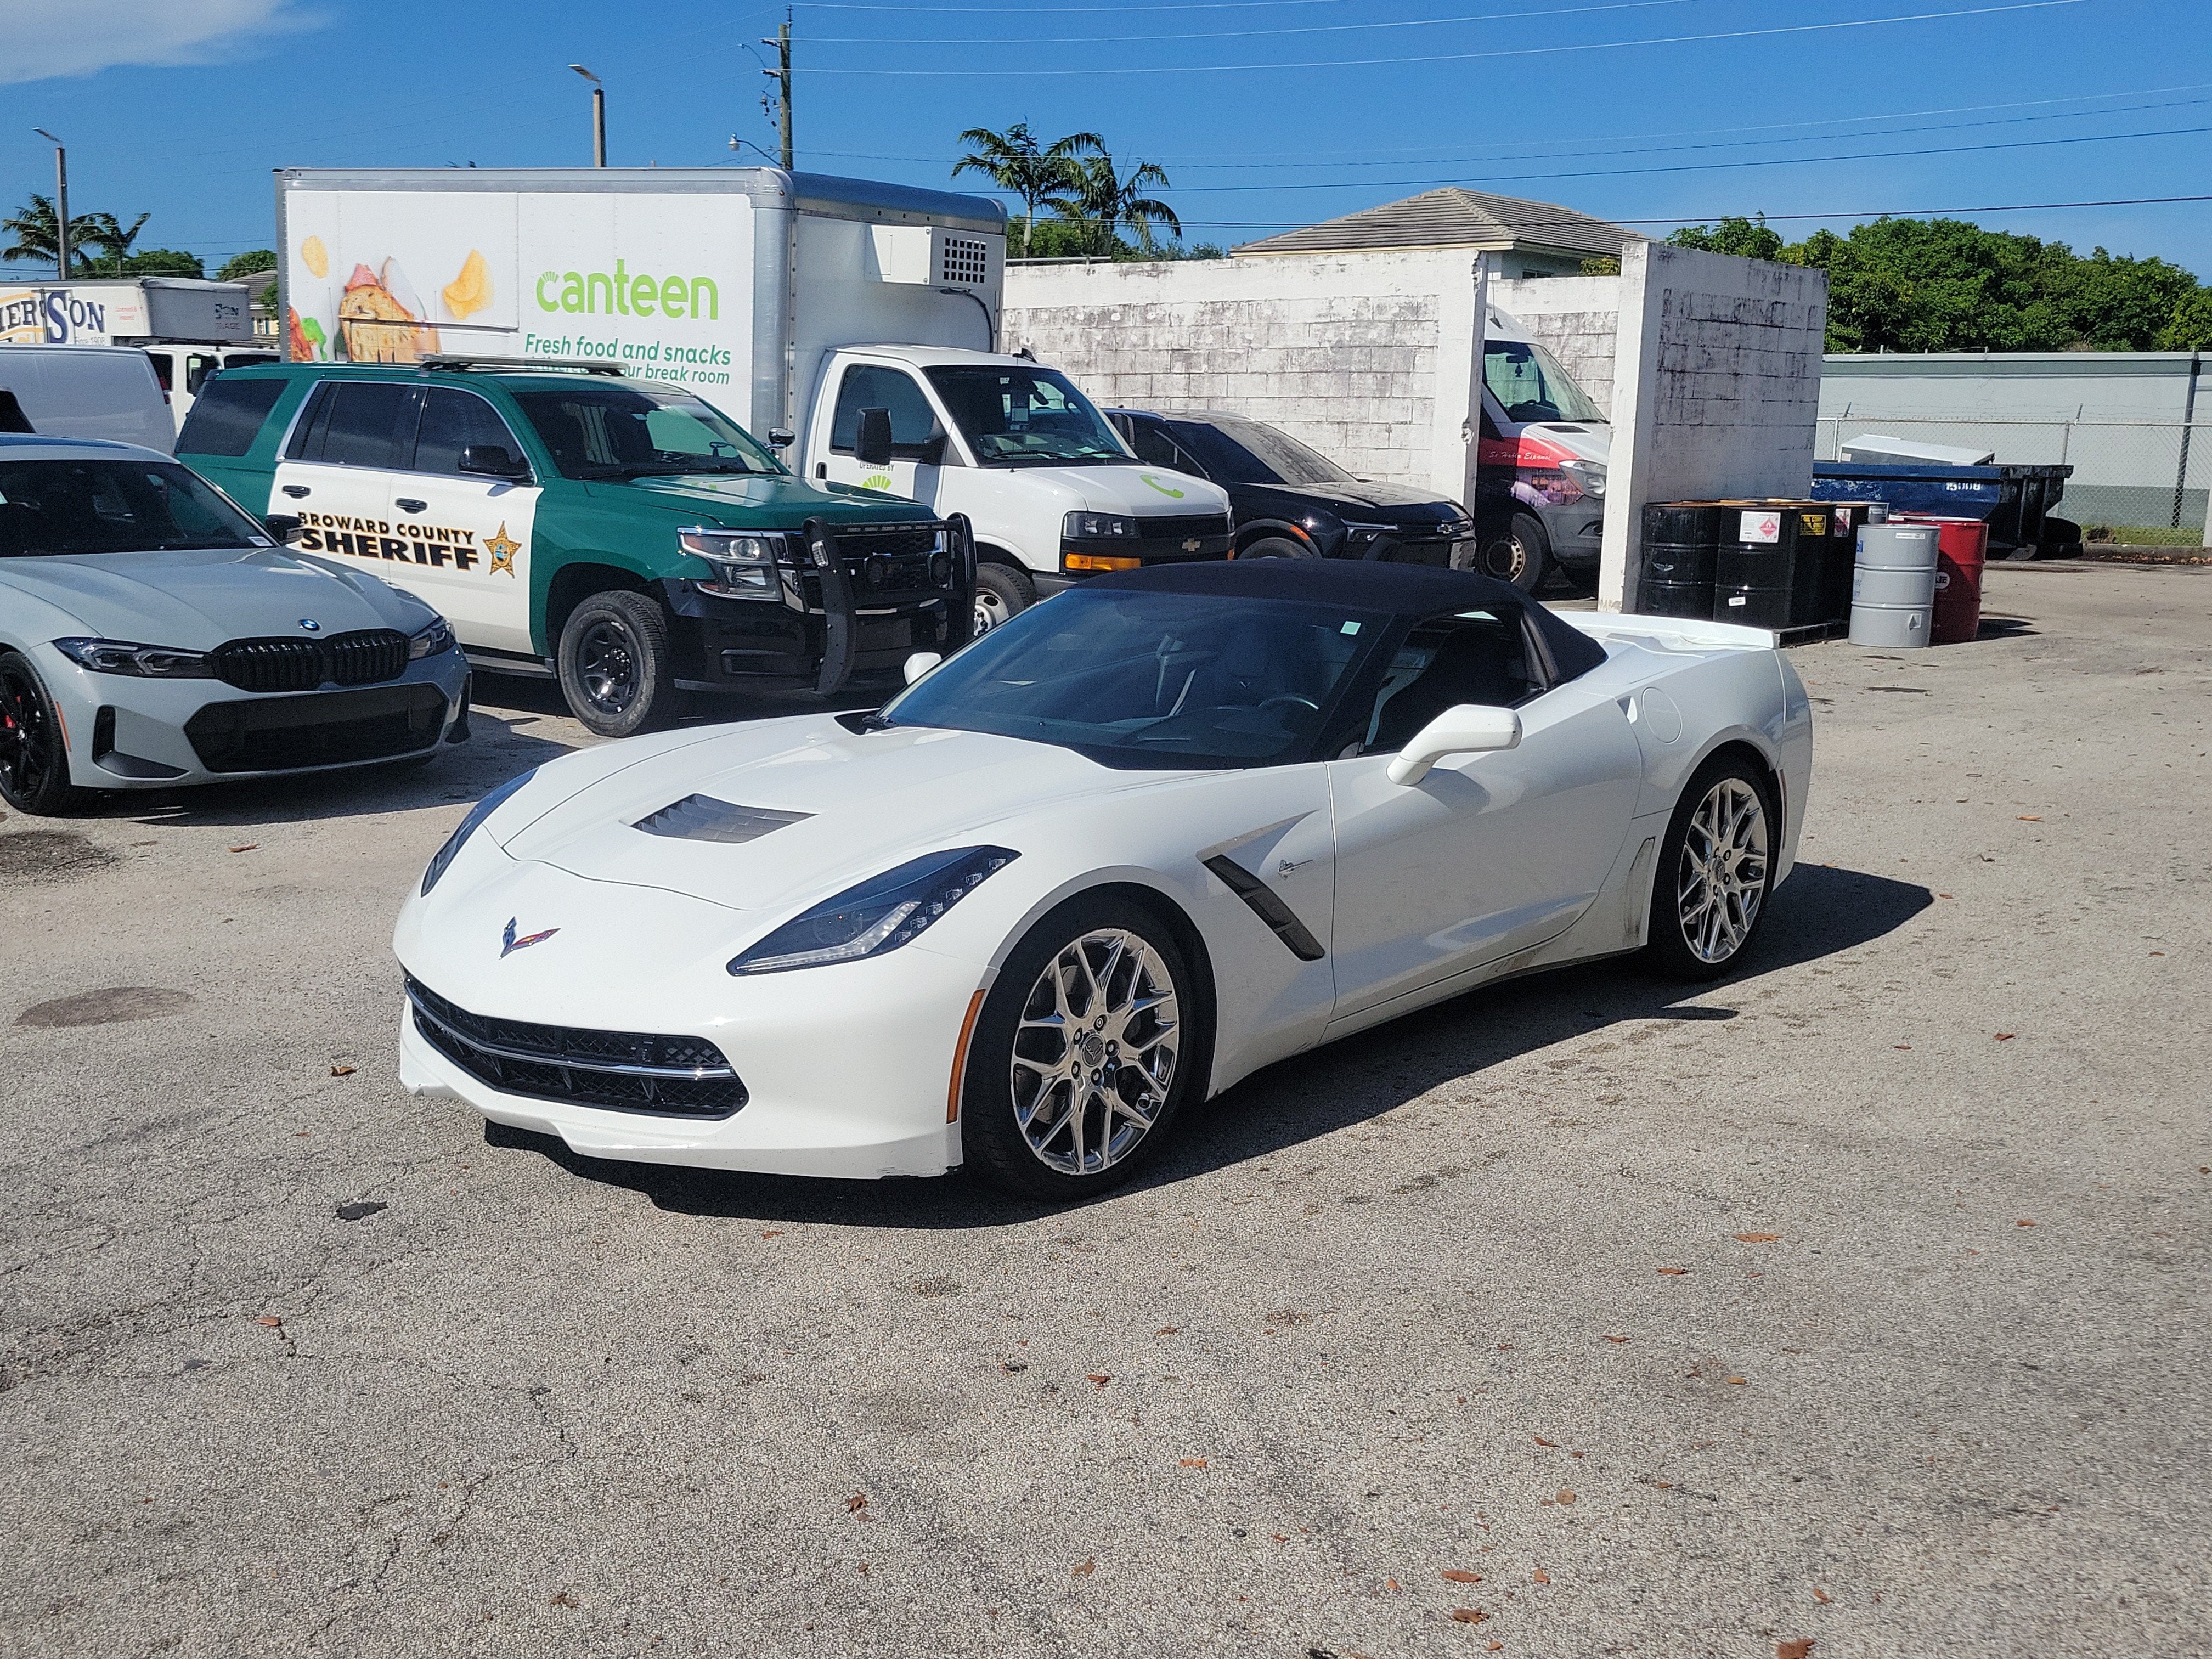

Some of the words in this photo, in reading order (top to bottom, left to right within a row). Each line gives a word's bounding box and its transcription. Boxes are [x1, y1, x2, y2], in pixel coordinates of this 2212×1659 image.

[536, 258, 718, 320] canteen
[525, 334, 571, 355] Fresh
[577, 336, 619, 358] food
[623, 341, 661, 361] and
[664, 345, 731, 366] snacks
[646, 364, 689, 382] break
[693, 370, 730, 385] room
[297, 511, 390, 534] BROWARD
[397, 523, 476, 545] COUNTY
[301, 528, 480, 571] SHERIFF
